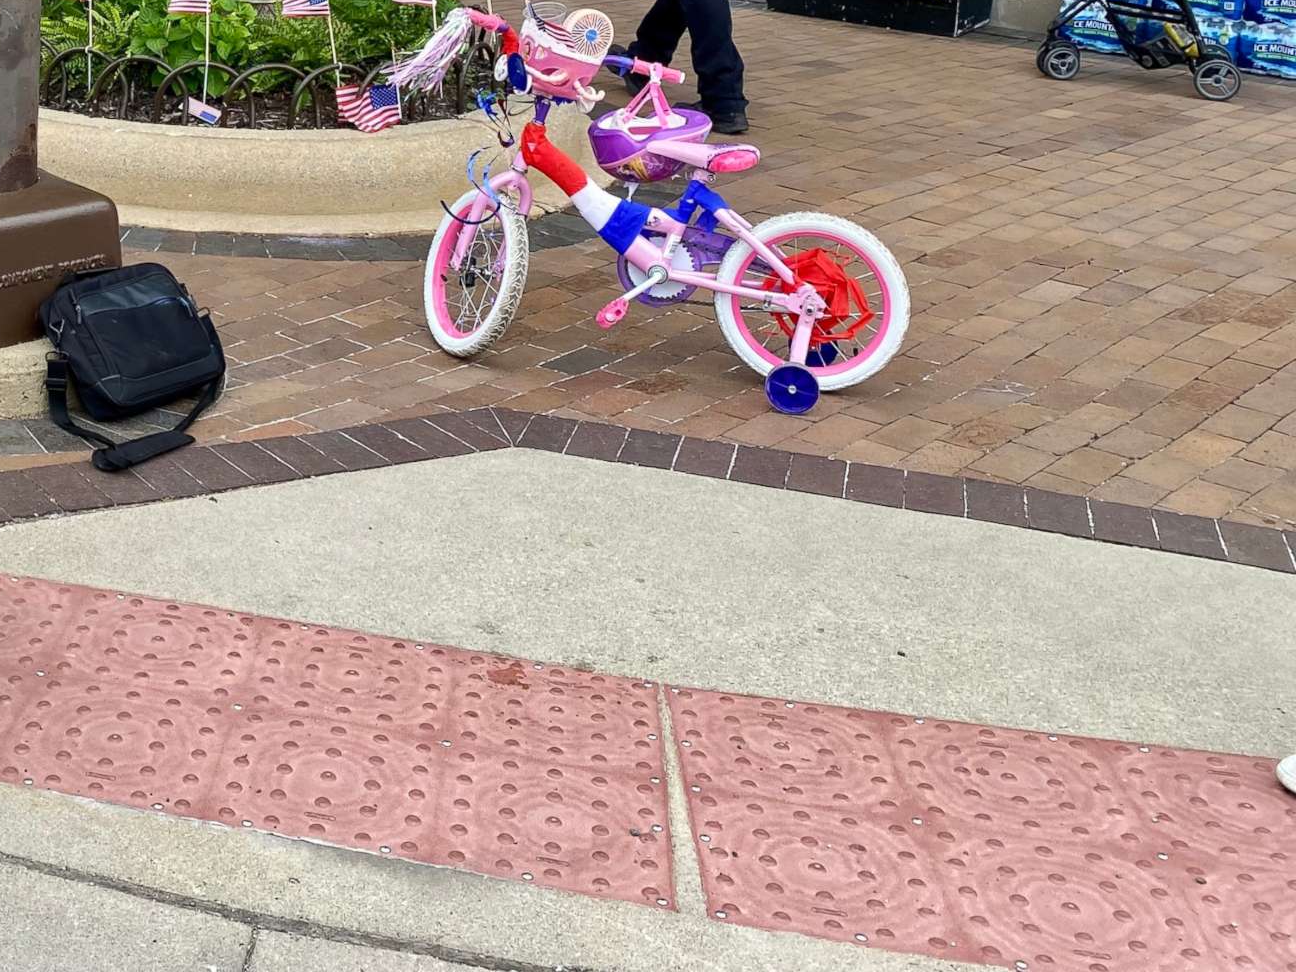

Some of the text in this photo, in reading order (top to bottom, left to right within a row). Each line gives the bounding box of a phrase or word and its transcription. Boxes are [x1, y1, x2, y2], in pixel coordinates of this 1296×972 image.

[1074, 20, 1116, 32] CE MOUNTA
[1254, 43, 1268, 52] ICE
